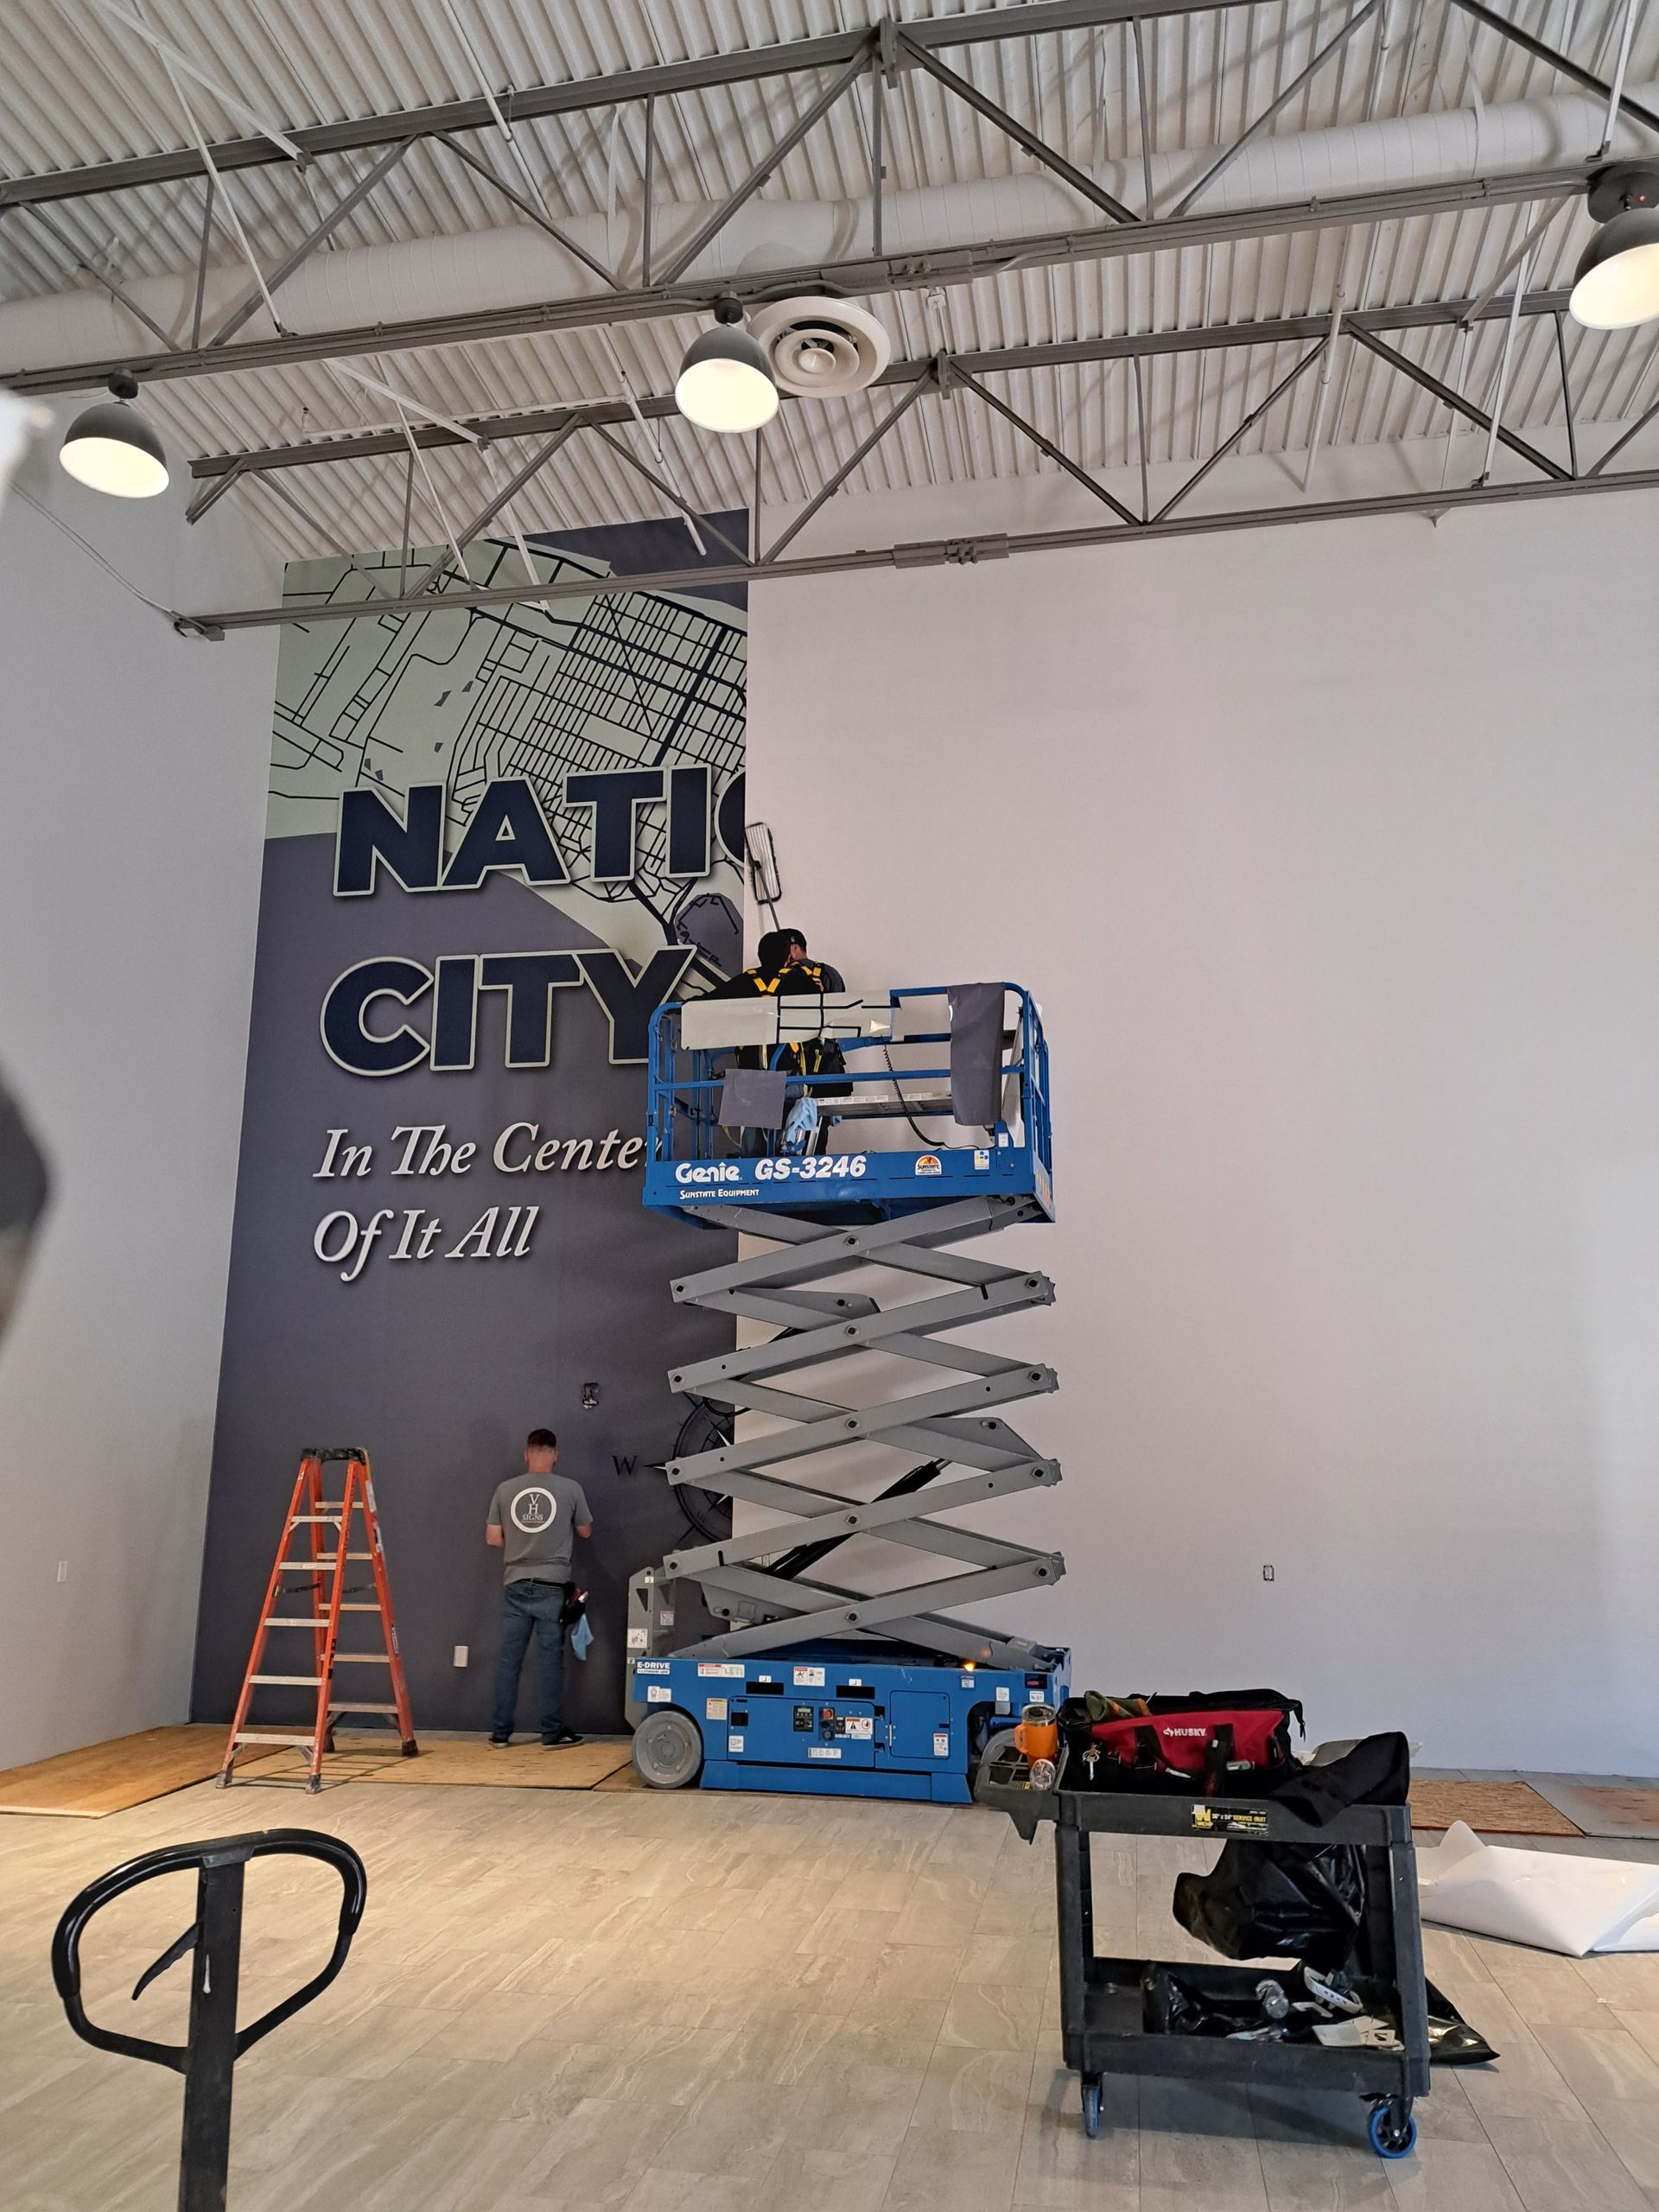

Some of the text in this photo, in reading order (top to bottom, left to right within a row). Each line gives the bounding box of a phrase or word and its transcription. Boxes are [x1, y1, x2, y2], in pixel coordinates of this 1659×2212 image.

[334, 763, 745, 896] NATI
[320, 944, 697, 1077] CITY
[312, 1128, 372, 1178] In
[391, 1124, 476, 1176] The
[675, 1155, 867, 1184] Genie GS-3246
[679, 1188, 760, 1199] SUNSTATE EQUIPMENT
[314, 1205, 539, 1282] Of It All
[612, 1455, 639, 1476] W
[529, 1503, 538, 1514] H
[530, 1494, 540, 1504] V
[637, 1661, 671, 1669] E-DRIVE
[1173, 1727, 1207, 1737] HUSKY
